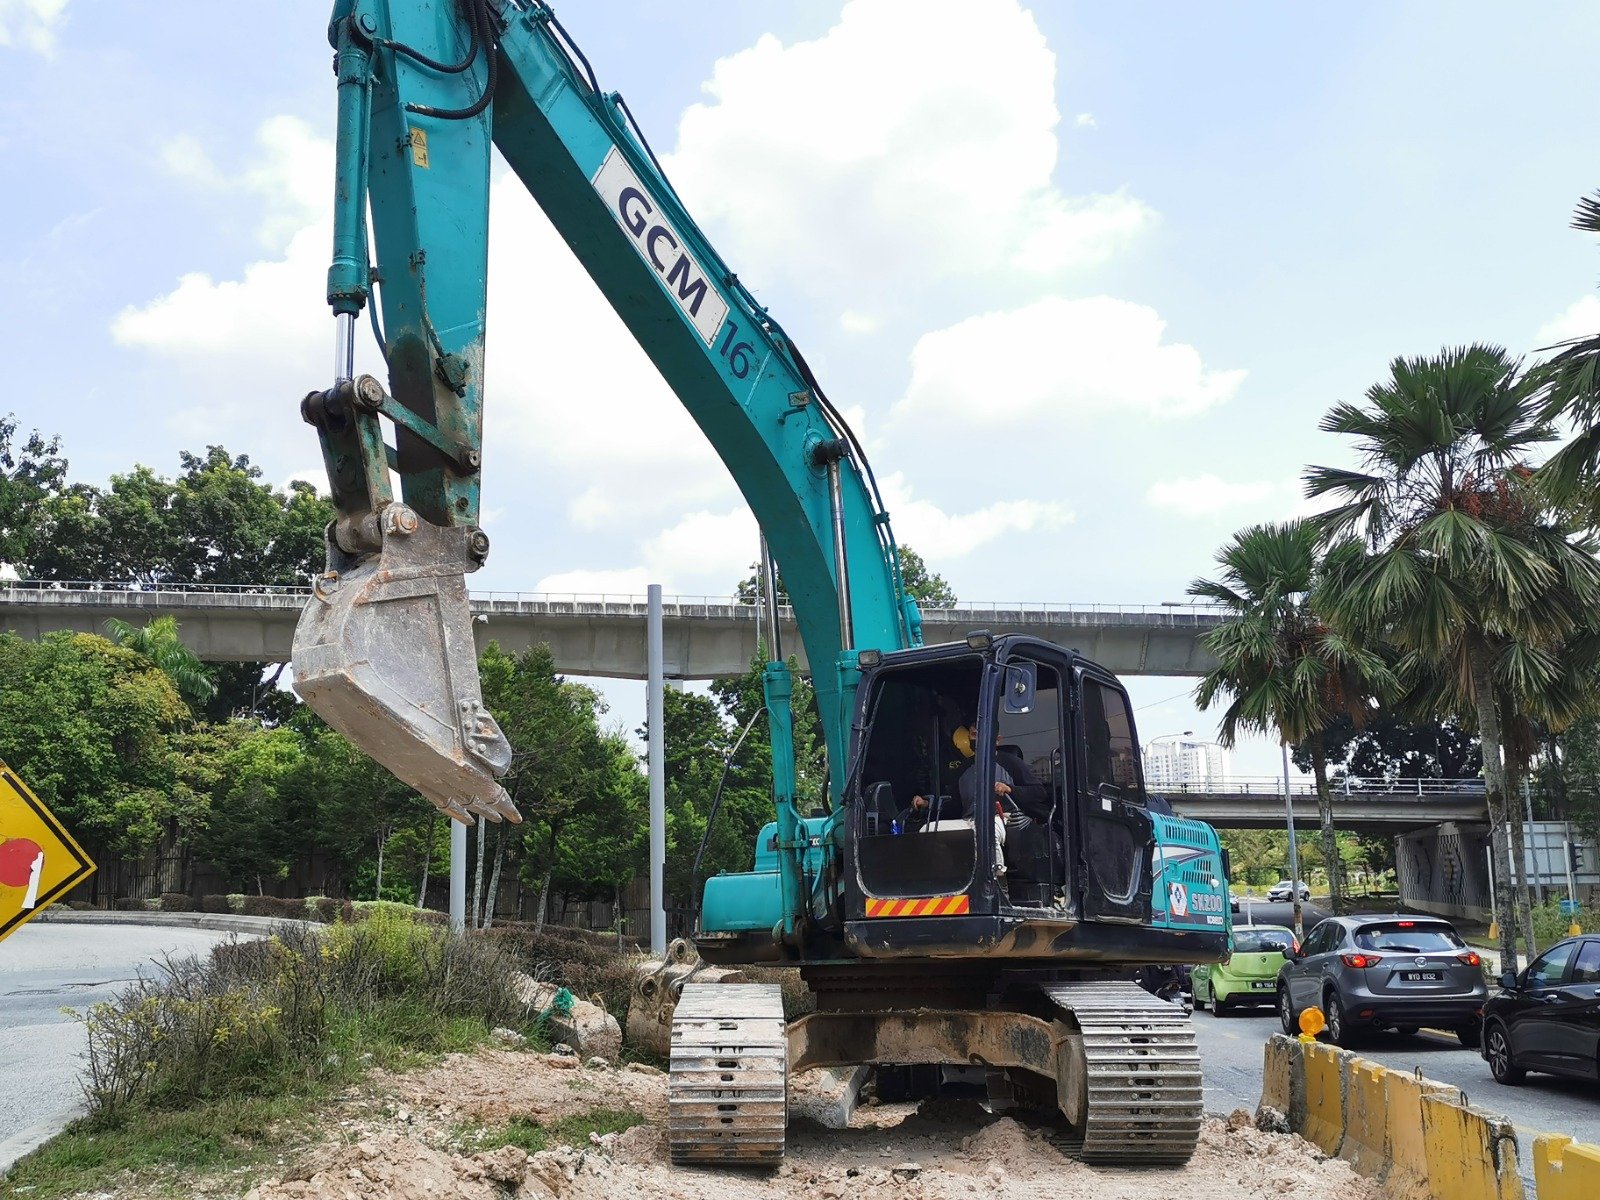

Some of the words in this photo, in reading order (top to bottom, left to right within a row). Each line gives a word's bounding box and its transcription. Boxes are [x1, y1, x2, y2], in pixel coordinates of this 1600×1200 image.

[618, 186, 708, 318] GCM
[721, 319, 755, 379] 16
[1191, 893, 1223, 912] SK200
